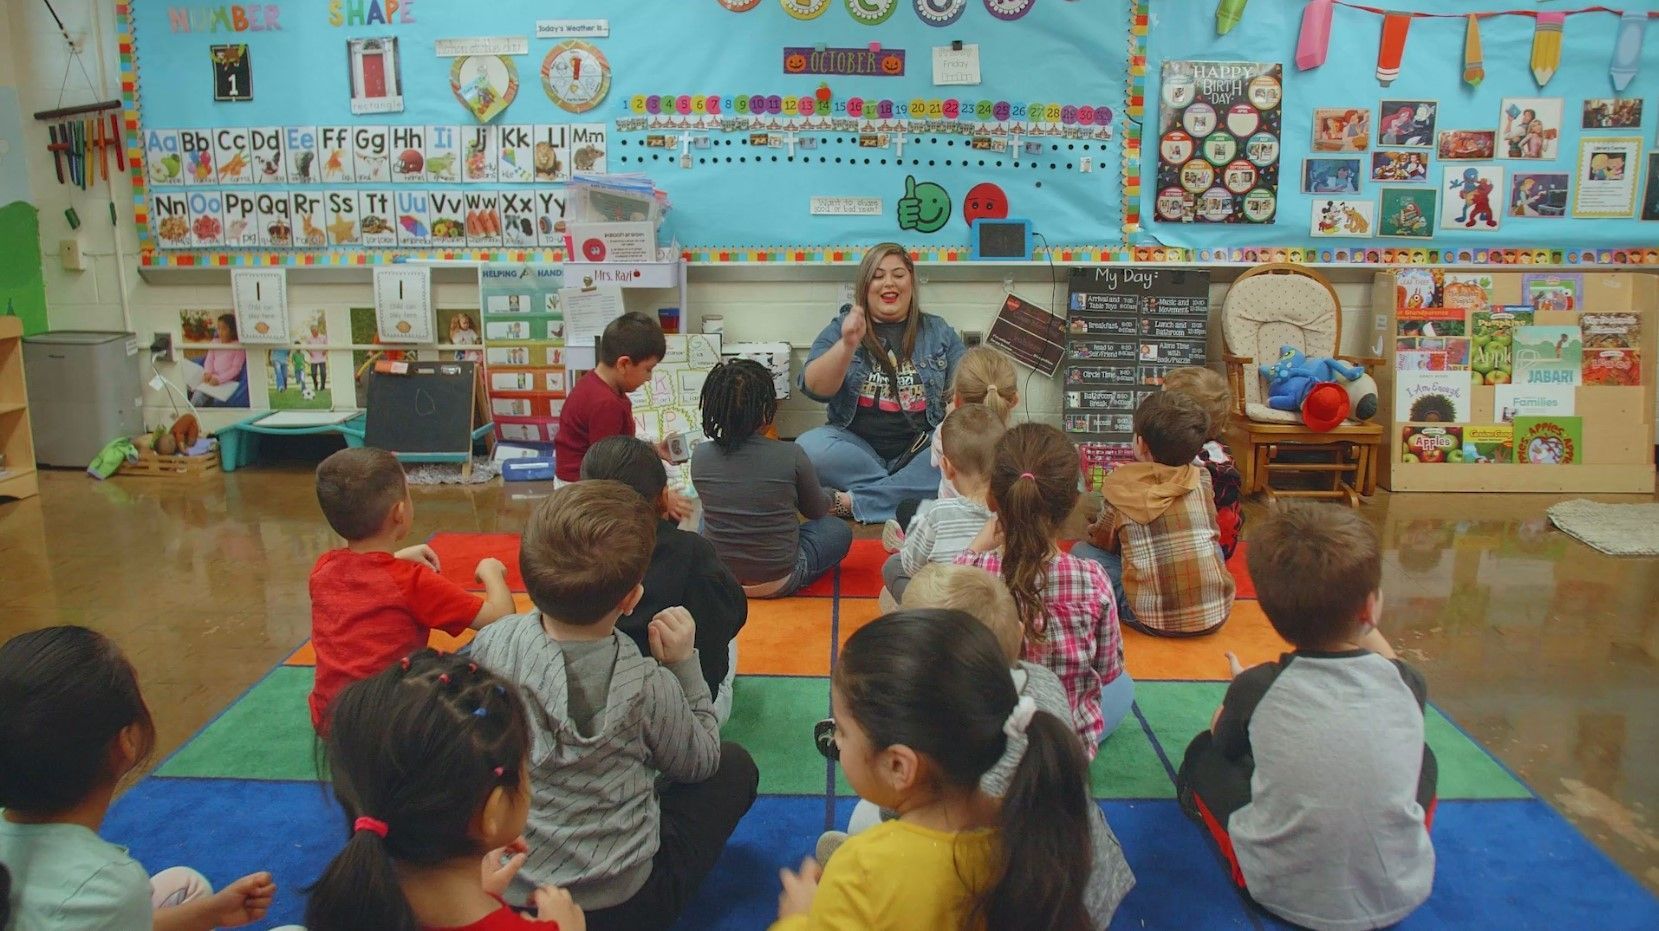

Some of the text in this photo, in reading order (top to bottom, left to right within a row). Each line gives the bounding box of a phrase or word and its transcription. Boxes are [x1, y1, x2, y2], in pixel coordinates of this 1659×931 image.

[167, 5, 283, 33] NUMBER
[328, 0, 417, 27] SHAPE
[566, 25, 594, 33] Weather
[810, 51, 877, 73] OCTOBER
[1193, 66, 1252, 79] HAPPY
[228, 74, 239, 96] 1
[1203, 79, 1242, 96] BIRTH
[353, 102, 403, 111] rectangle
[623, 100, 628, 109] 1
[636, 99, 643, 109] 2
[665, 99, 673, 109] 4
[681, 99, 688, 109] 5
[696, 100, 704, 109] 6
[711, 100, 718, 109] 7
[725, 100, 732, 109] 8
[740, 100, 747, 110] 9
[753, 99, 764, 109] 10
[769, 100, 779, 109] 11
[785, 100, 797, 110] 12
[802, 101, 813, 110] 13
[835, 102, 846, 112] 15
[851, 102, 862, 111] 16
[866, 105, 876, 114] 17
[881, 104, 892, 113] 18
[896, 105, 907, 114] 19
[911, 103, 925, 113] 20
[930, 104, 941, 114] 21
[944, 103, 958, 113] 22
[961, 104, 975, 113] 23
[979, 104, 991, 114] 24
[1013, 105, 1026, 116] 26
[1030, 107, 1043, 118] 27
[1047, 108, 1060, 118] 28
[148, 127, 605, 154] Aa Bb Cc Dd Ee Ff Gg Hh Ii Jj Kk Ll Mm
[155, 193, 566, 219] Nn Oo Pp Qq Rr Ss Tt Uu Vv Ww Xx Yy
[242, 234, 256, 245] pig
[483, 269, 563, 279] HELPING HAND
[594, 269, 614, 281] Mrs.
[1095, 269, 1160, 290] My Day:
[1154, 320, 1175, 328] Lunch
[655, 375, 667, 391] K
[682, 376, 696, 391] L
[1527, 369, 1574, 384] JABARI
[1406, 381, 1461, 398] I Am Enough
[1513, 397, 1558, 407] Families
[1415, 436, 1450, 451] Apples
